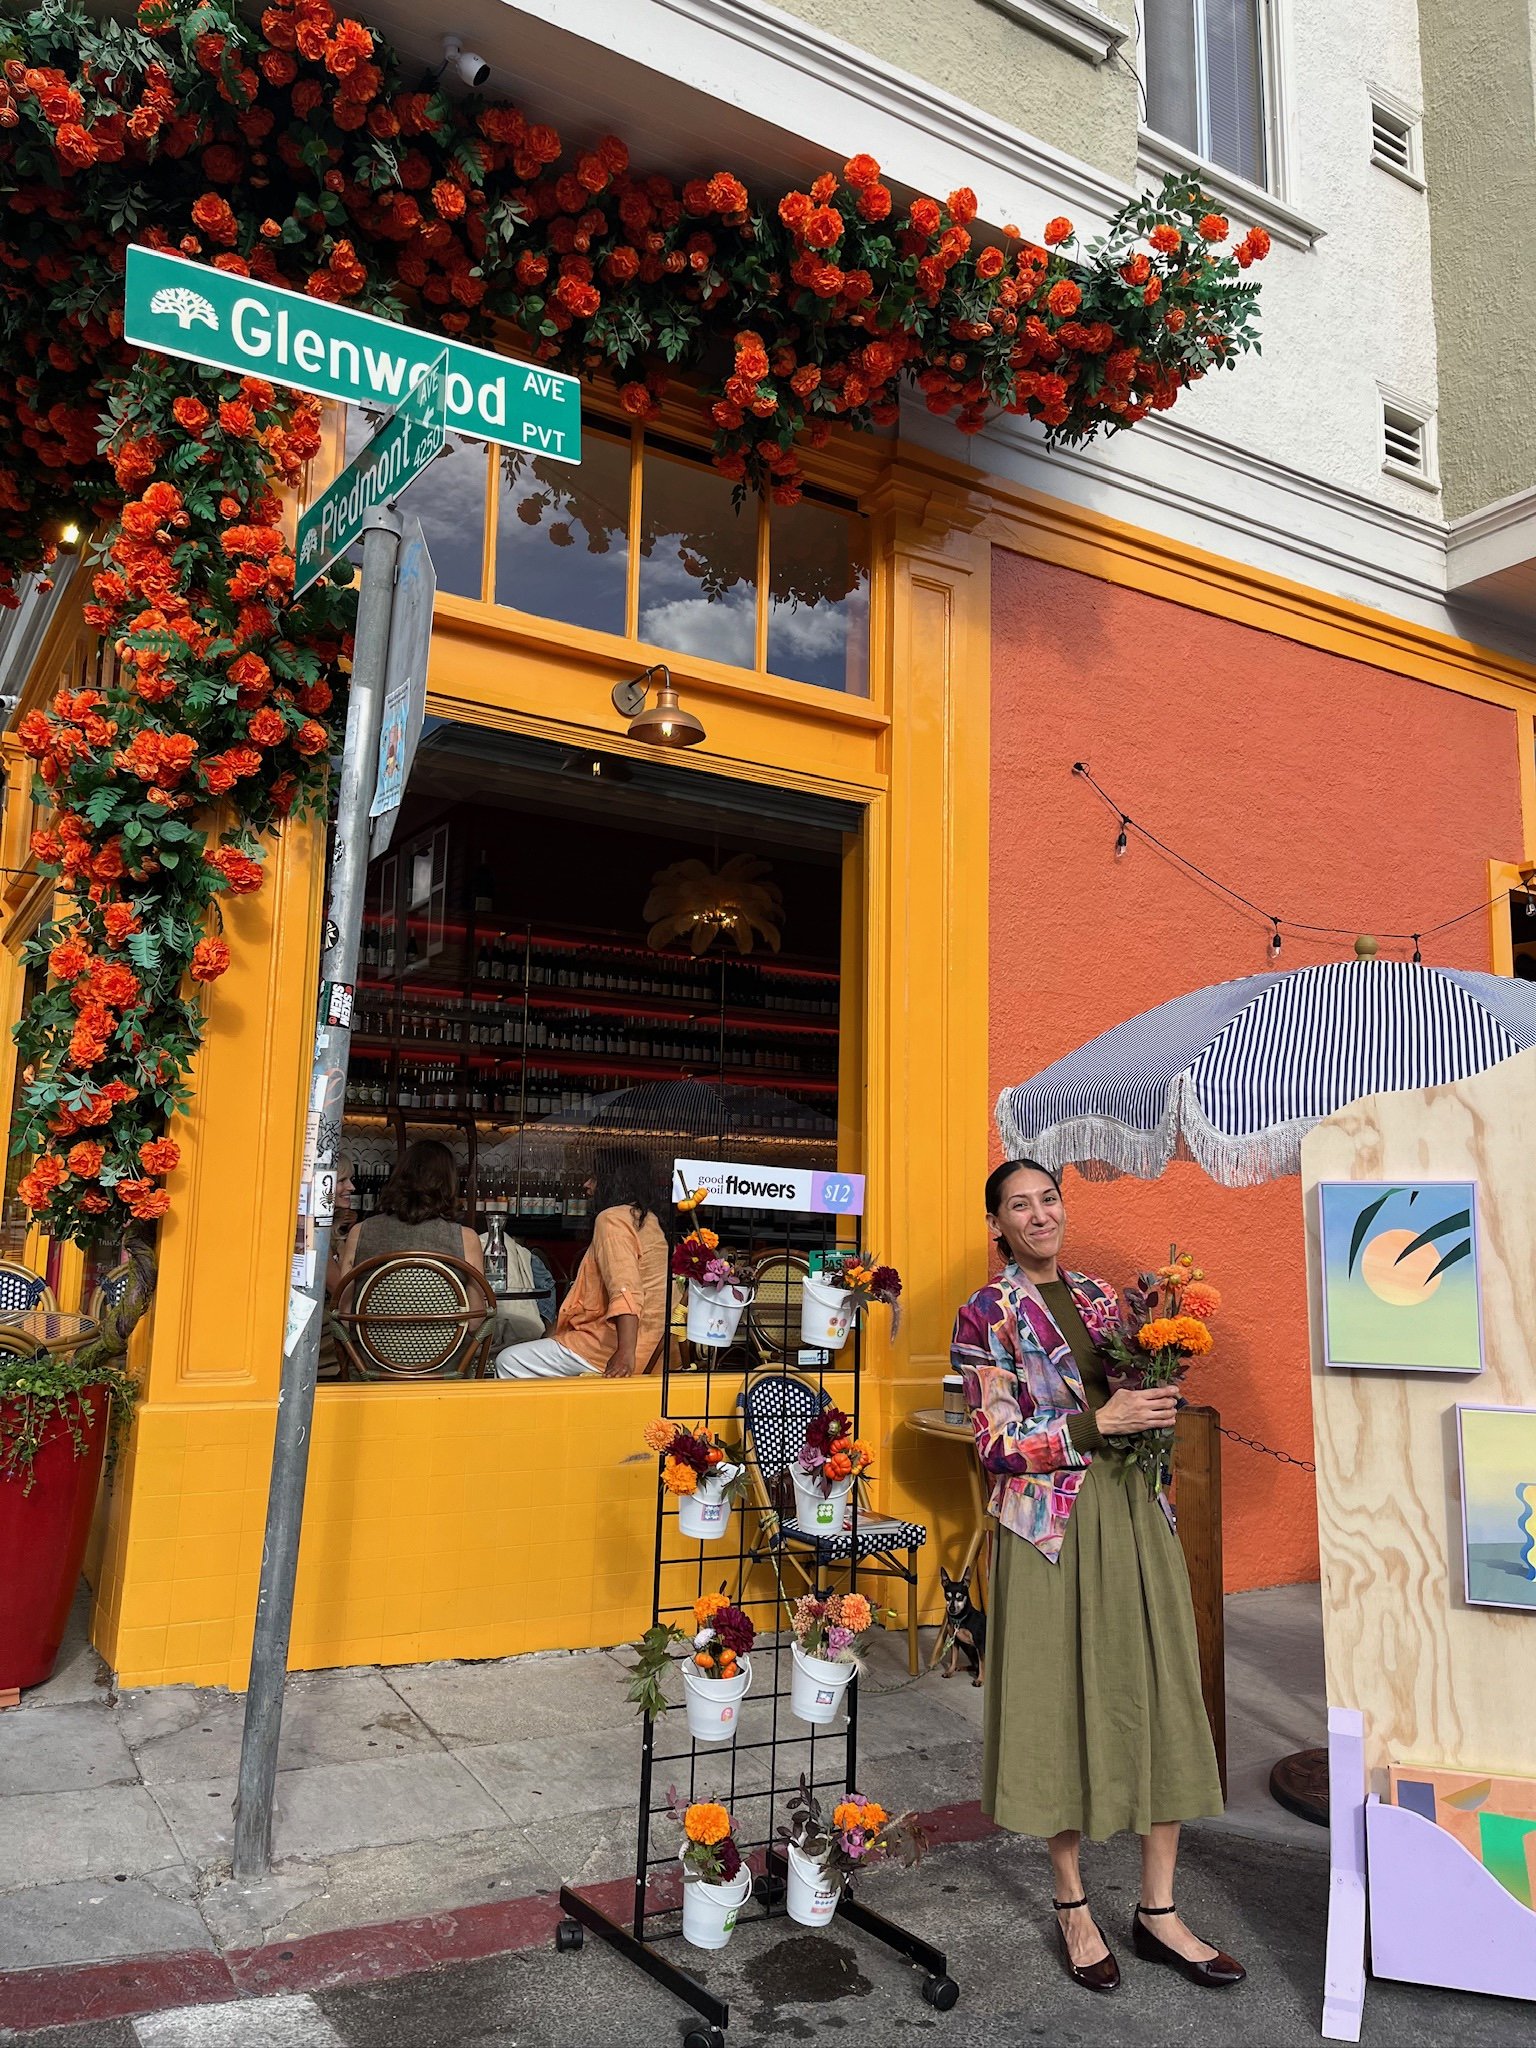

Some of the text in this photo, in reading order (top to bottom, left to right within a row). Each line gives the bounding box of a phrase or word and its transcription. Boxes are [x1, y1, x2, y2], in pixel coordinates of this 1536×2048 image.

[420, 366, 439, 407] AVE
[523, 371, 566, 403] AVE
[413, 426, 440, 468] 4250
[522, 421, 566, 453] PVT
[320, 413, 412, 556] Piedmont
[328, 983, 345, 1019] SKEM
[698, 1174, 724, 1186] good
[725, 1175, 796, 1200] flowers
[824, 1184, 850, 1203] $12
[824, 1258, 843, 1269] PAS
